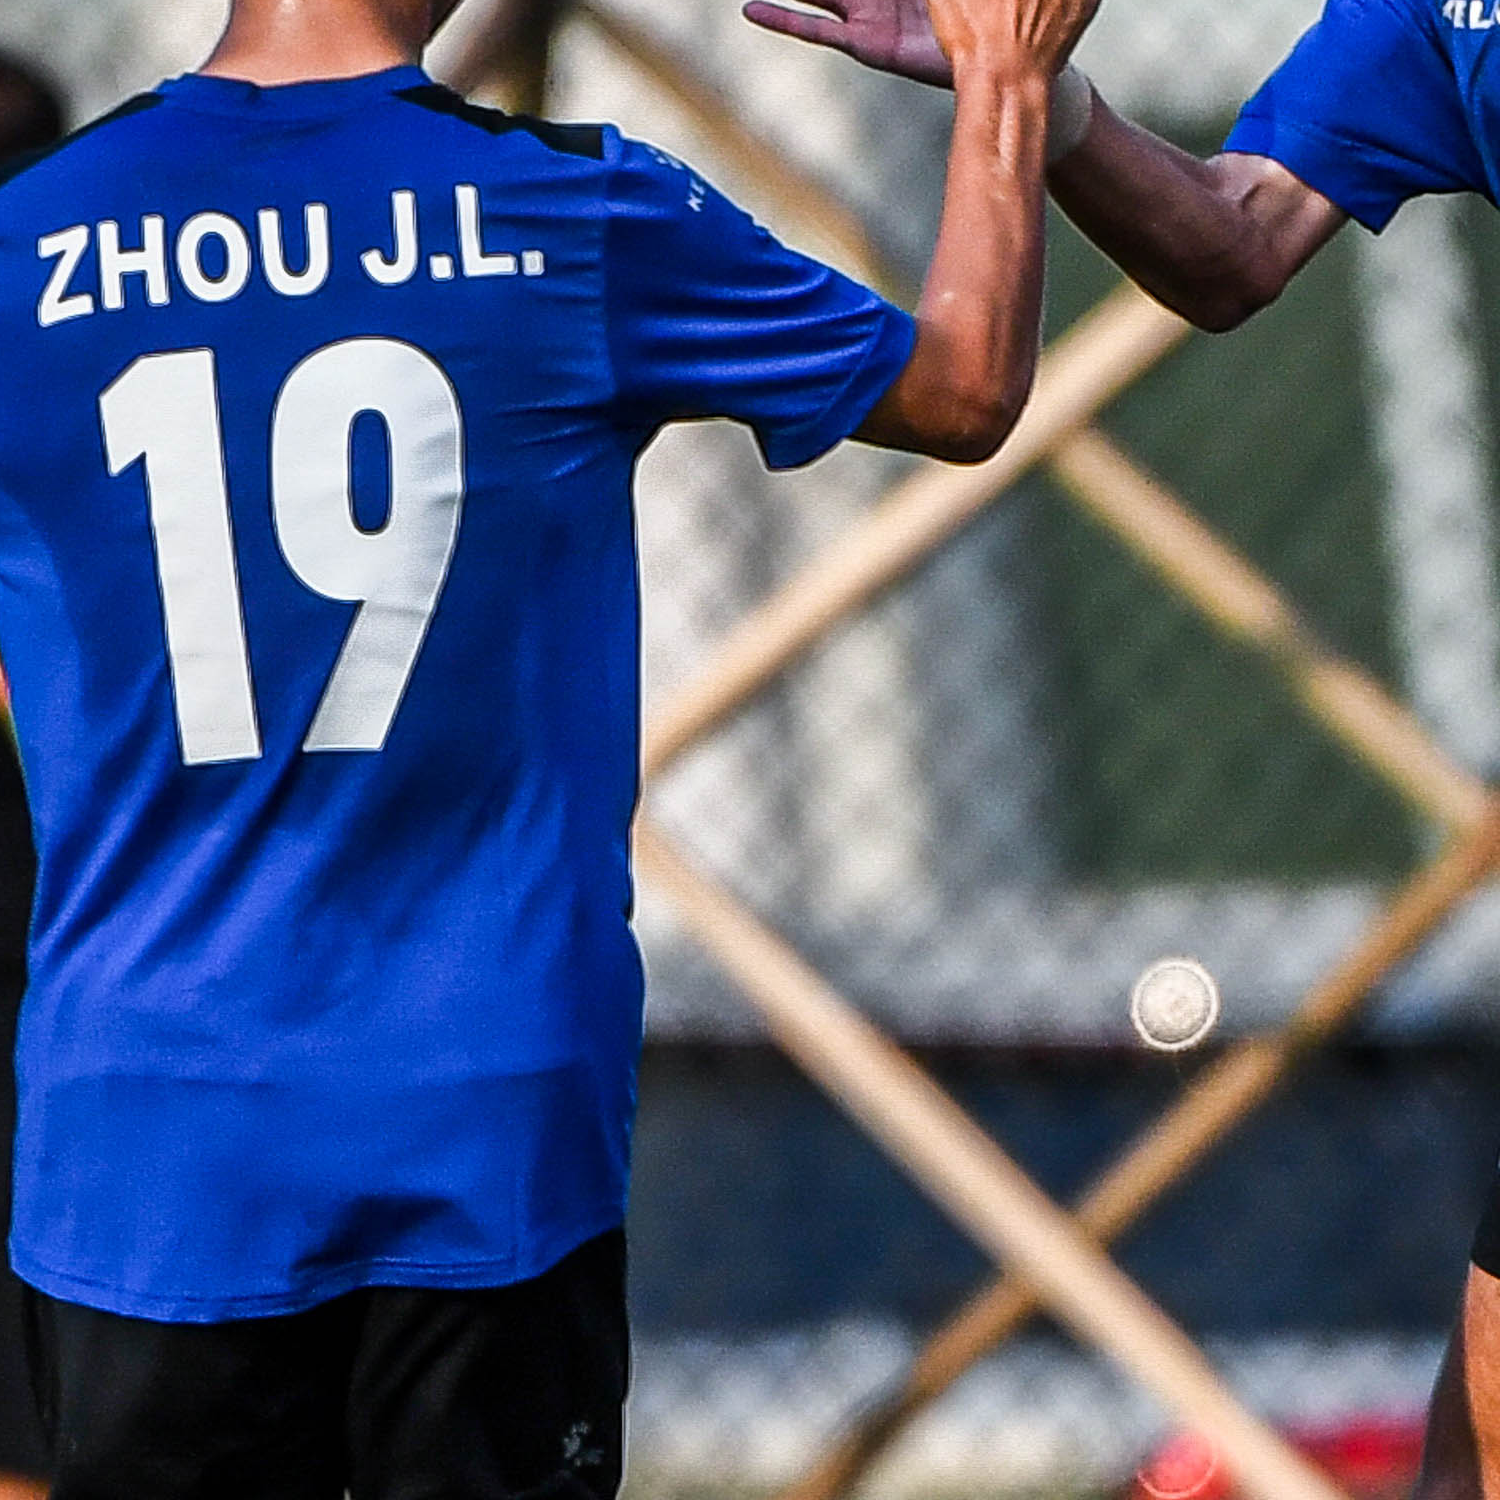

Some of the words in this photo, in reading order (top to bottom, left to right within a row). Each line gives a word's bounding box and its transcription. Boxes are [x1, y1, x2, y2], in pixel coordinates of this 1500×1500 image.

[37, 200, 330, 328] ZHOU
[361, 184, 547, 288] J.L.
[98, 337, 465, 768] 19
